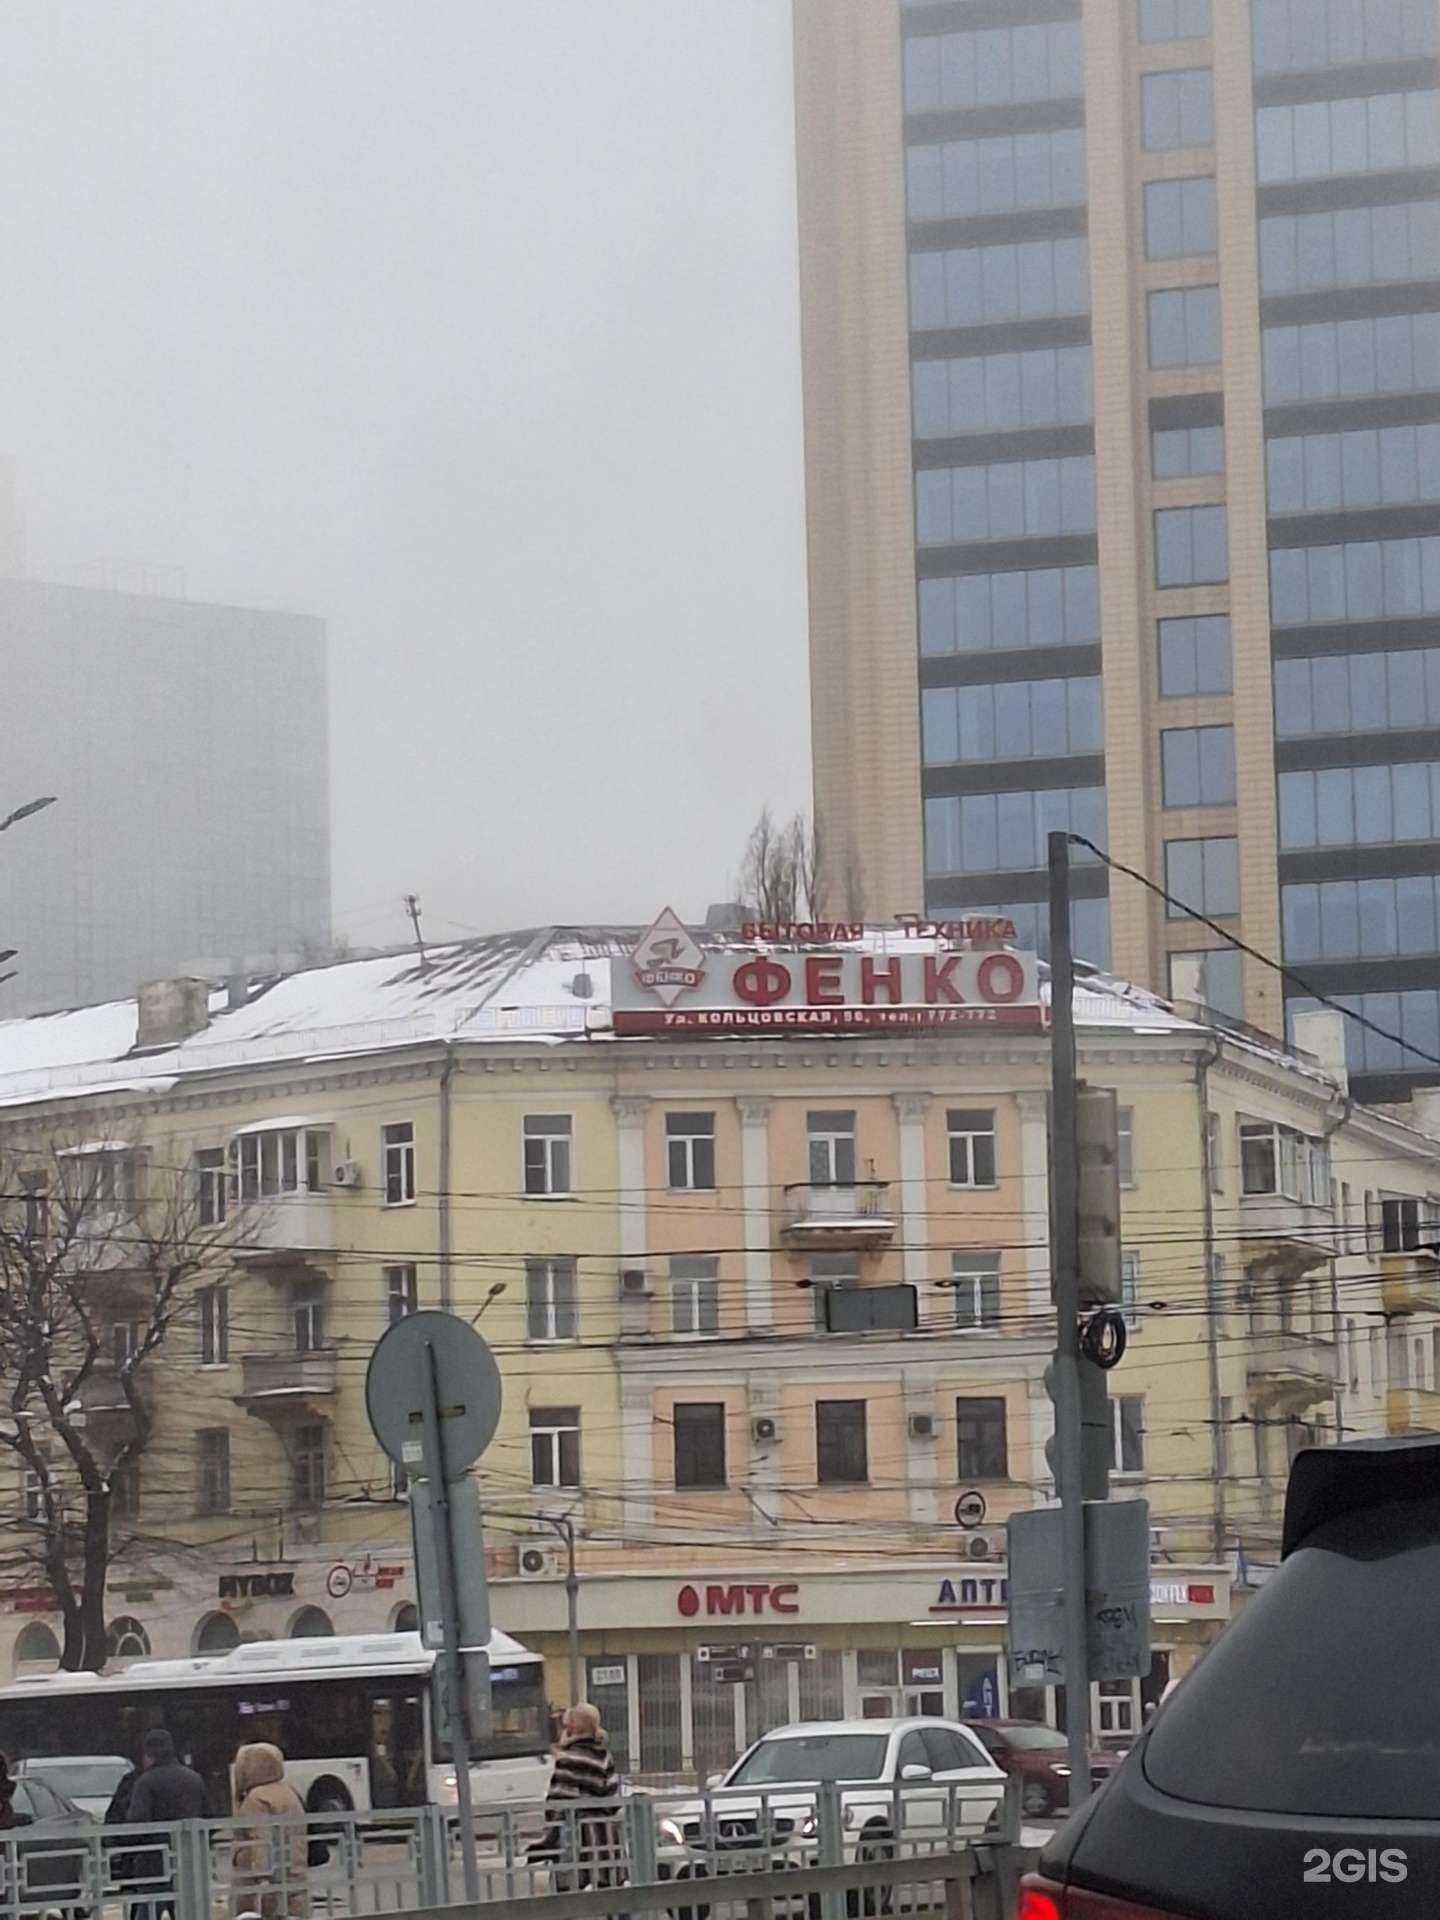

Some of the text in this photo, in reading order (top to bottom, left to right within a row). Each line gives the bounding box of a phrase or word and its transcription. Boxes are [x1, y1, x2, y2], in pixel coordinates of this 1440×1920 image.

[904, 919, 1018, 940] ТЕХНИКА
[732, 953, 1025, 1006] ФЕНКО
[928, 1009, 997, 1022] 772-772
[706, 1584, 799, 1615] МТС
